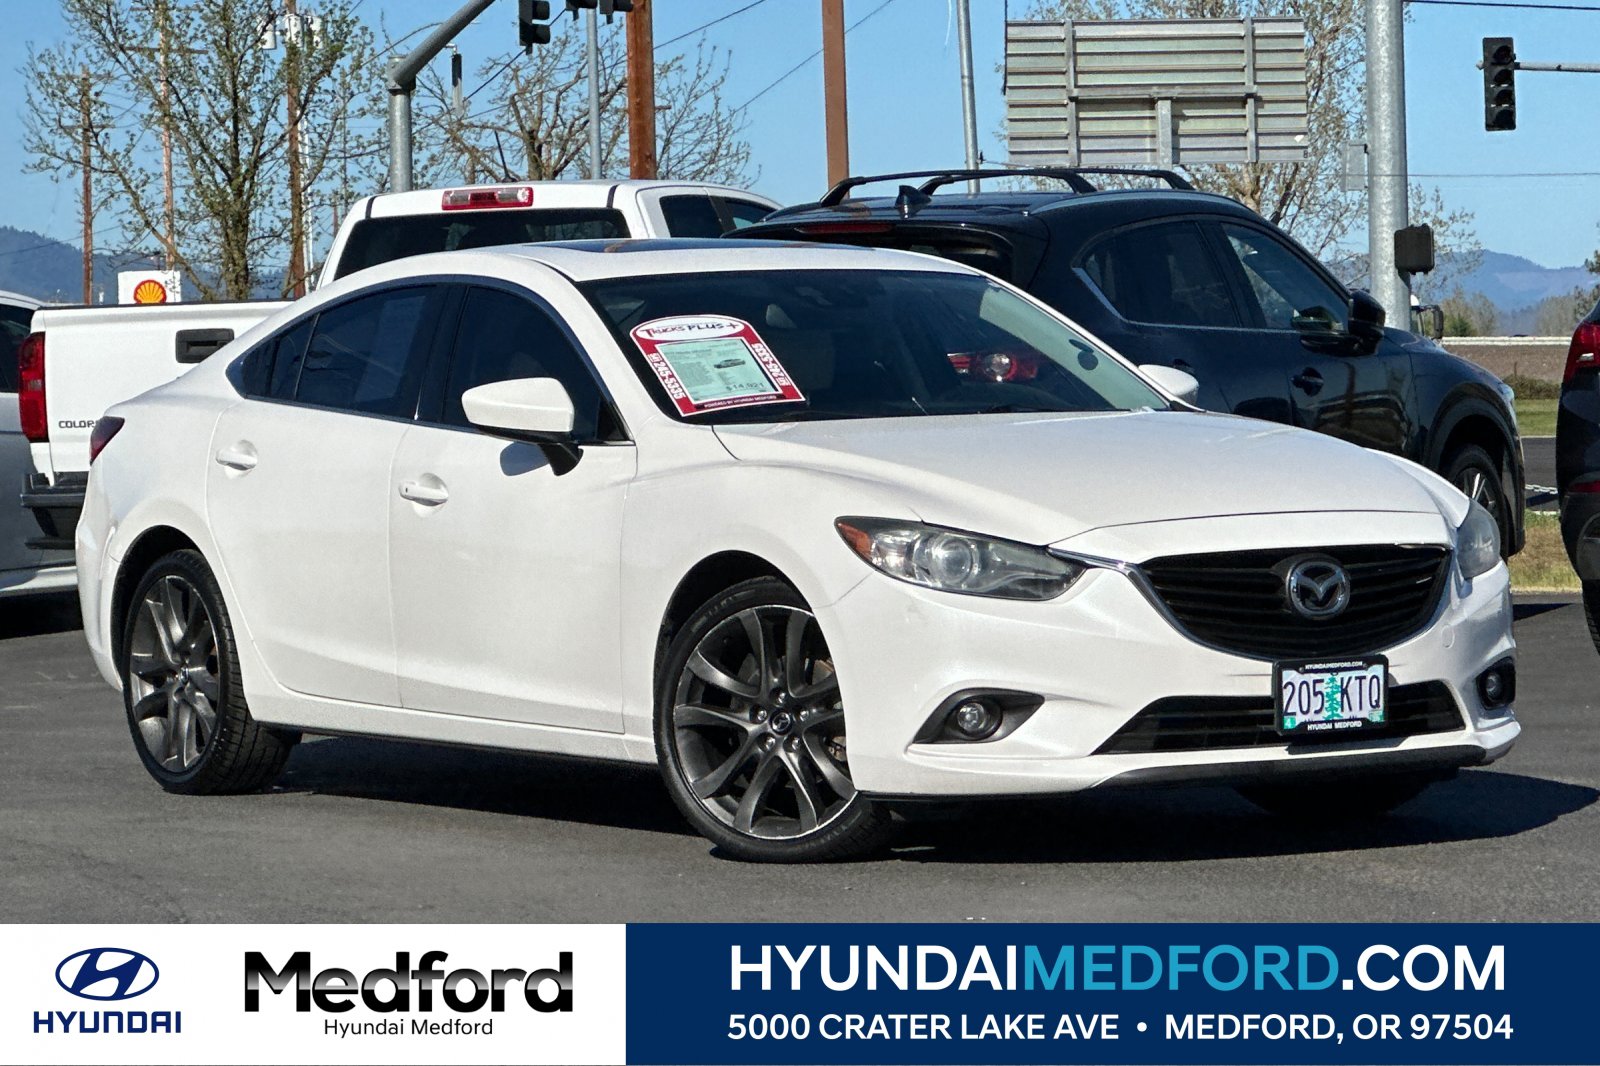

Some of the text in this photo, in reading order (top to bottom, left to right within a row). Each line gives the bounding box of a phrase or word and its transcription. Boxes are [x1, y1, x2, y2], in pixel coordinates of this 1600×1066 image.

[653, 361, 686, 399] 245-5335
[1305, 661, 1363, 670] HYUNDAIMEDFORD.COM
[1283, 674, 1381, 716] 205 KTQ
[1307, 721, 1362, 731] HYUNDAI MEDFORD
